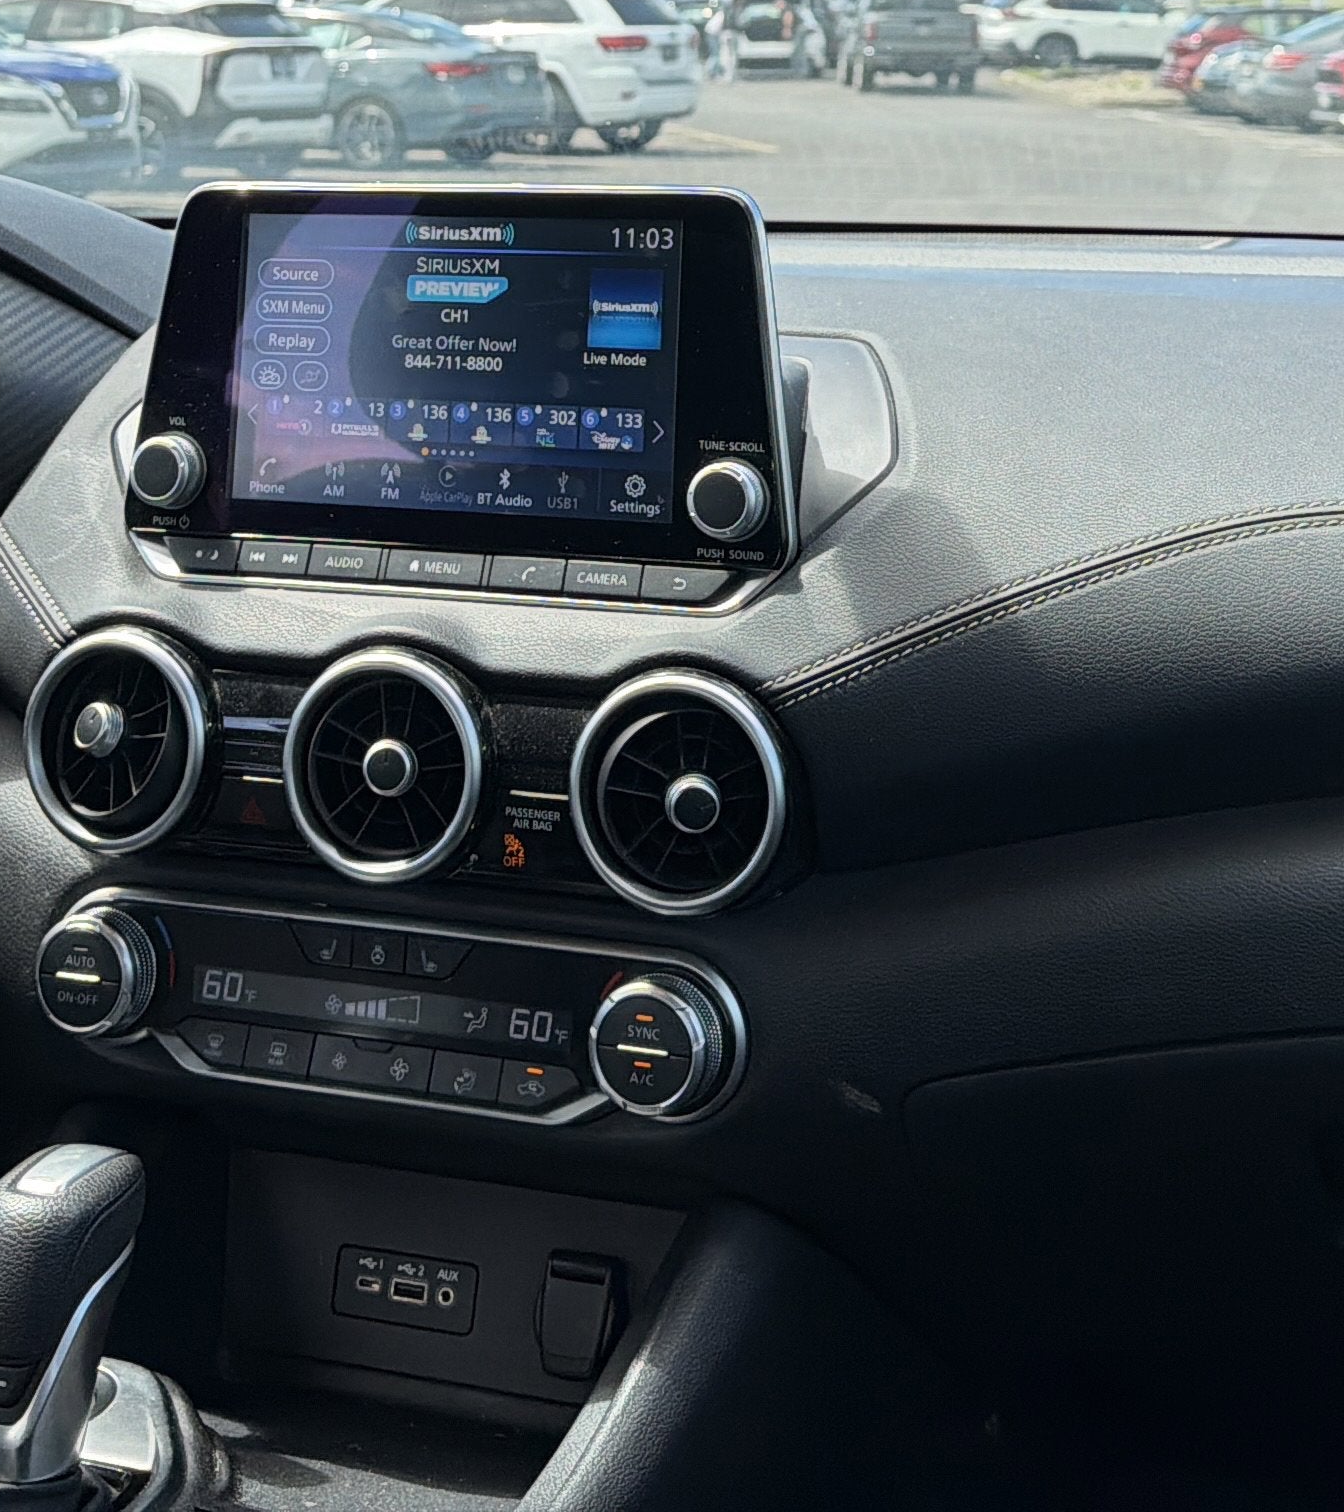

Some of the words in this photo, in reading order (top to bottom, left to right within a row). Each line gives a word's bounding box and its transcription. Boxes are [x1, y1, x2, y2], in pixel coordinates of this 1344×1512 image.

[611, 227, 675, 250] 11:03
[272, 266, 320, 282] Source
[416, 256, 500, 275] SIRIUSXM
[414, 280, 500, 297] PREVIEW
[262, 299, 289, 314] SXM
[292, 300, 325, 315] Menu
[440, 308, 469, 324] CH1
[268, 332, 316, 350] Replay
[391, 334, 432, 350] Great
[436, 335, 474, 351] Offer
[478, 337, 517, 353] Now!
[404, 354, 503, 372] 844-711-8800
[583, 351, 608, 365] Live
[610, 352, 647, 367] Mode
[168, 416, 187, 427] VOL
[313, 399, 323, 415] 2
[368, 402, 385, 418] 13
[421, 404, 449, 420] 136
[456, 407, 466, 419] 4
[485, 407, 513, 423] 136
[520, 409, 529, 422] 5
[549, 409, 577, 426] 302
[585, 412, 594, 425] 6
[615, 413, 643, 429] 133
[249, 480, 286, 495] Phone
[322, 484, 345, 497] AM
[380, 486, 400, 500] FM
[419, 490, 442, 504] Apple
[476, 492, 492, 506] BT
[494, 493, 533, 508] Audio
[547, 495, 579, 510] USB1
[609, 499, 661, 518] Settings
[152, 515, 177, 526] PUSH
[324, 555, 364, 570] AUDIO
[696, 546, 724, 560] PUSH
[728, 548, 765, 562] SOUND
[424, 559, 462, 576] MENU
[576, 570, 629, 587] CAMERA
[505, 805, 561, 822] PASSENGER
[512, 817, 530, 830] AIR
[532, 819, 553, 832] BAG
[502, 855, 526, 868] OFF
[64, 954, 96, 968] AUTO
[202, 968, 244, 1003] 60
[509, 1007, 554, 1043] 60
[626, 1023, 662, 1042] SYNC
[628, 1071, 655, 1088] A/C
[417, 1263, 425, 1277] 2
[436, 1268, 460, 1283] AUX
